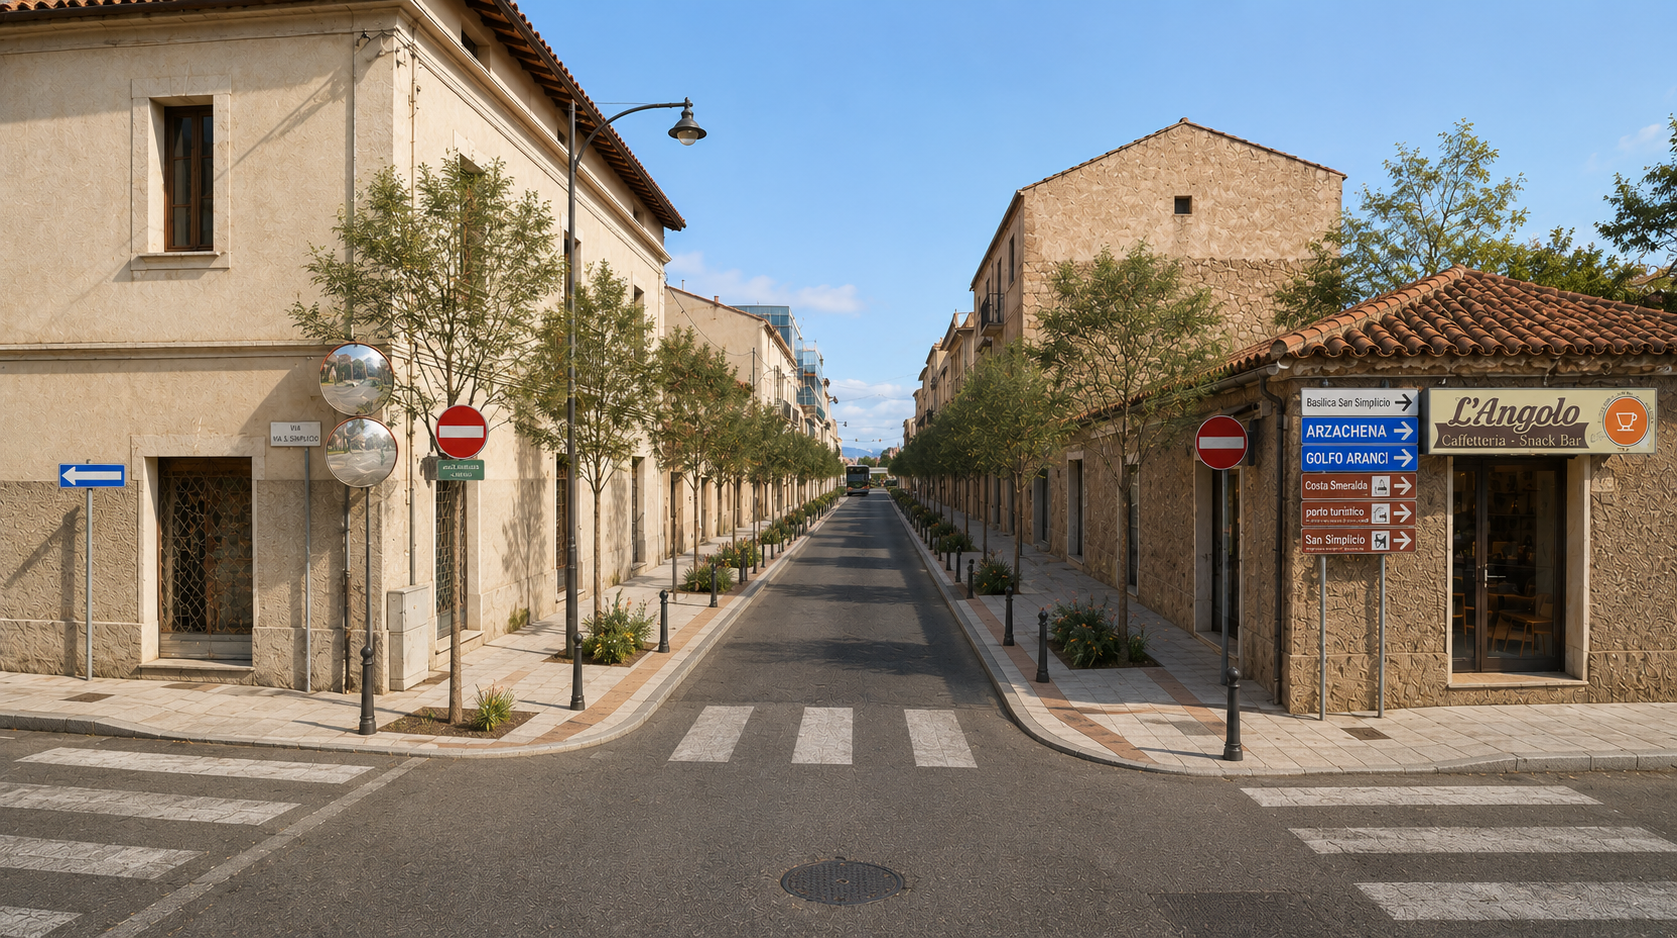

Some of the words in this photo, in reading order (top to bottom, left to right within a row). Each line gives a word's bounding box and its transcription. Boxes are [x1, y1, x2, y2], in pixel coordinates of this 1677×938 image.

[1306, 397, 1336, 407] Basilica
[1338, 398, 1352, 407] San
[1354, 397, 1391, 409] Simplicio
[1448, 396, 1580, 432] L'Angolo
[1306, 424, 1387, 438] ARZACHENA
[1441, 433, 1506, 447] Caffetteria
[1519, 433, 1556, 447] Snack
[1560, 434, 1582, 447] Bar
[1306, 452, 1343, 464] GOLFO
[1346, 452, 1388, 464] ARANCI
[1305, 480, 1328, 490] Costa
[1330, 480, 1368, 490] Smeralda
[1305, 507, 1328, 518] porto
[1305, 534, 1322, 545] San
[1325, 534, 1366, 546] Simplicio
